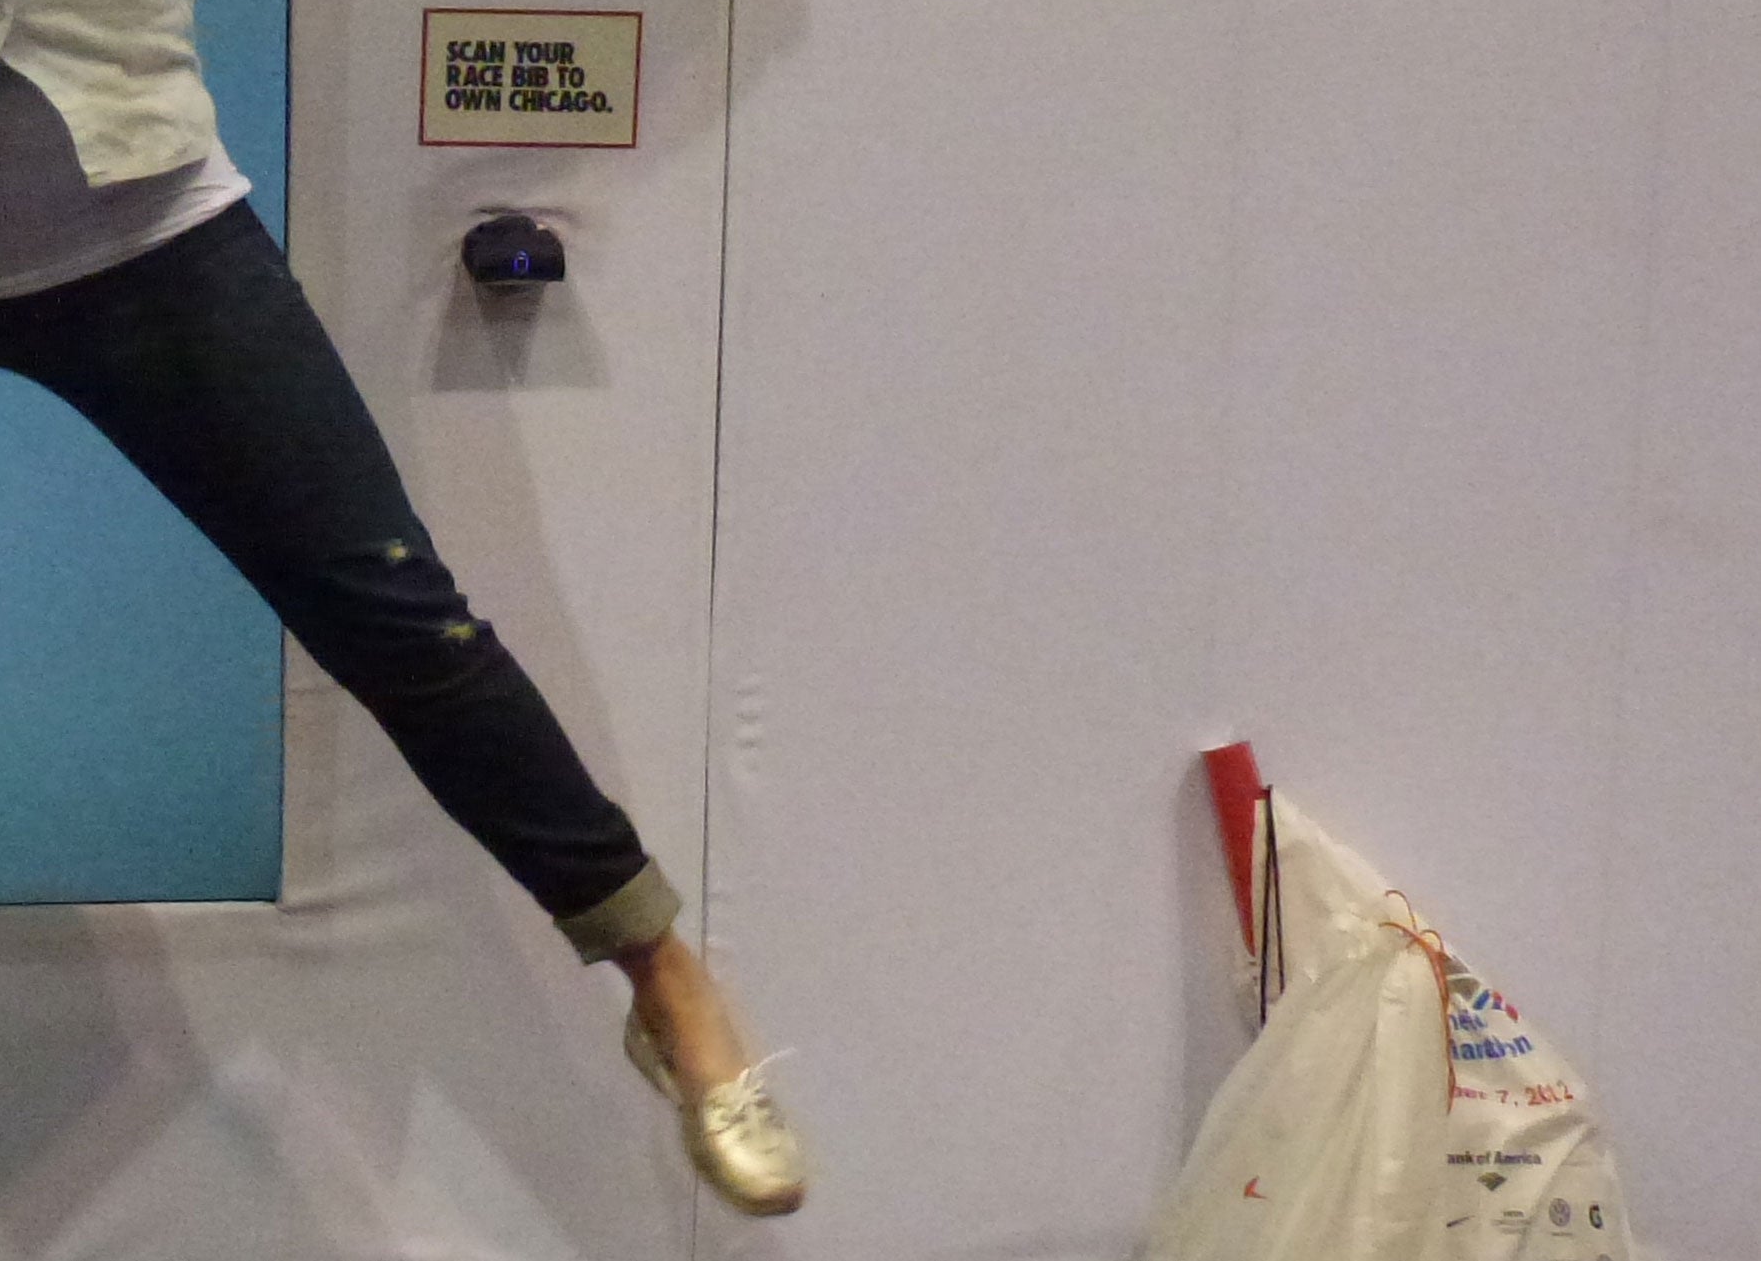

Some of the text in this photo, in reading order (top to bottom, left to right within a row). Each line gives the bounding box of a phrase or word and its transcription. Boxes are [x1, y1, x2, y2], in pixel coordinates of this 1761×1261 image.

[446, 40, 574, 64] SCAN YOUR
[446, 65, 585, 88] RACE BIB TO
[445, 89, 613, 113] OWN CHICAGO.
